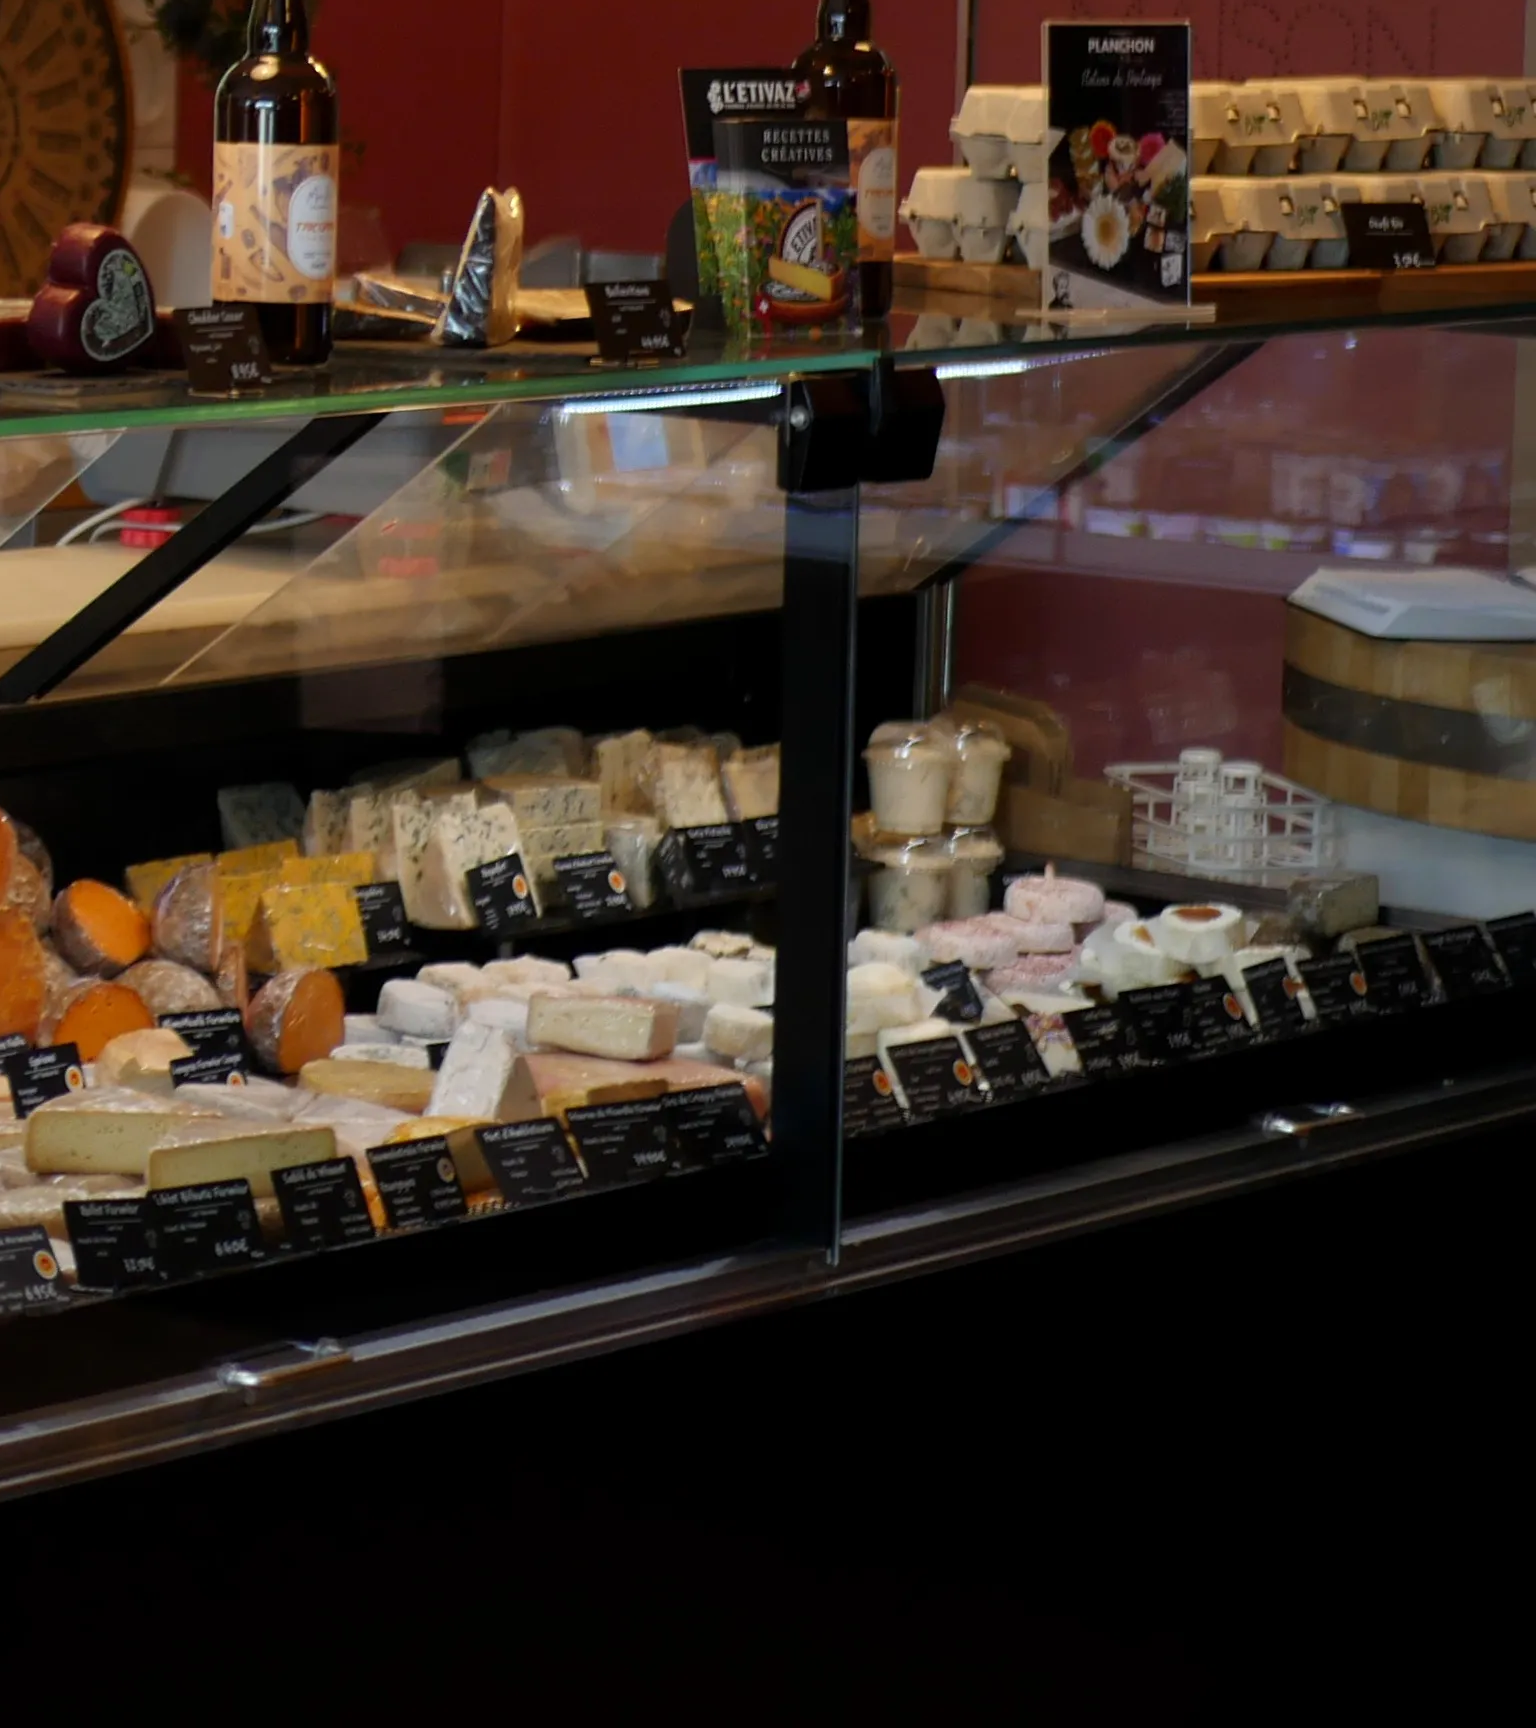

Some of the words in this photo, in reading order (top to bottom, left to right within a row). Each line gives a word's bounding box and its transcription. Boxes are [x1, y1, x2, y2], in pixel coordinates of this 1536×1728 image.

[1087, 36, 1156, 54] PLANCHON
[722, 80, 796, 105] L'ETIVAZ
[762, 127, 831, 144] RECETTES
[760, 144, 834, 163] CRÉATIVES
